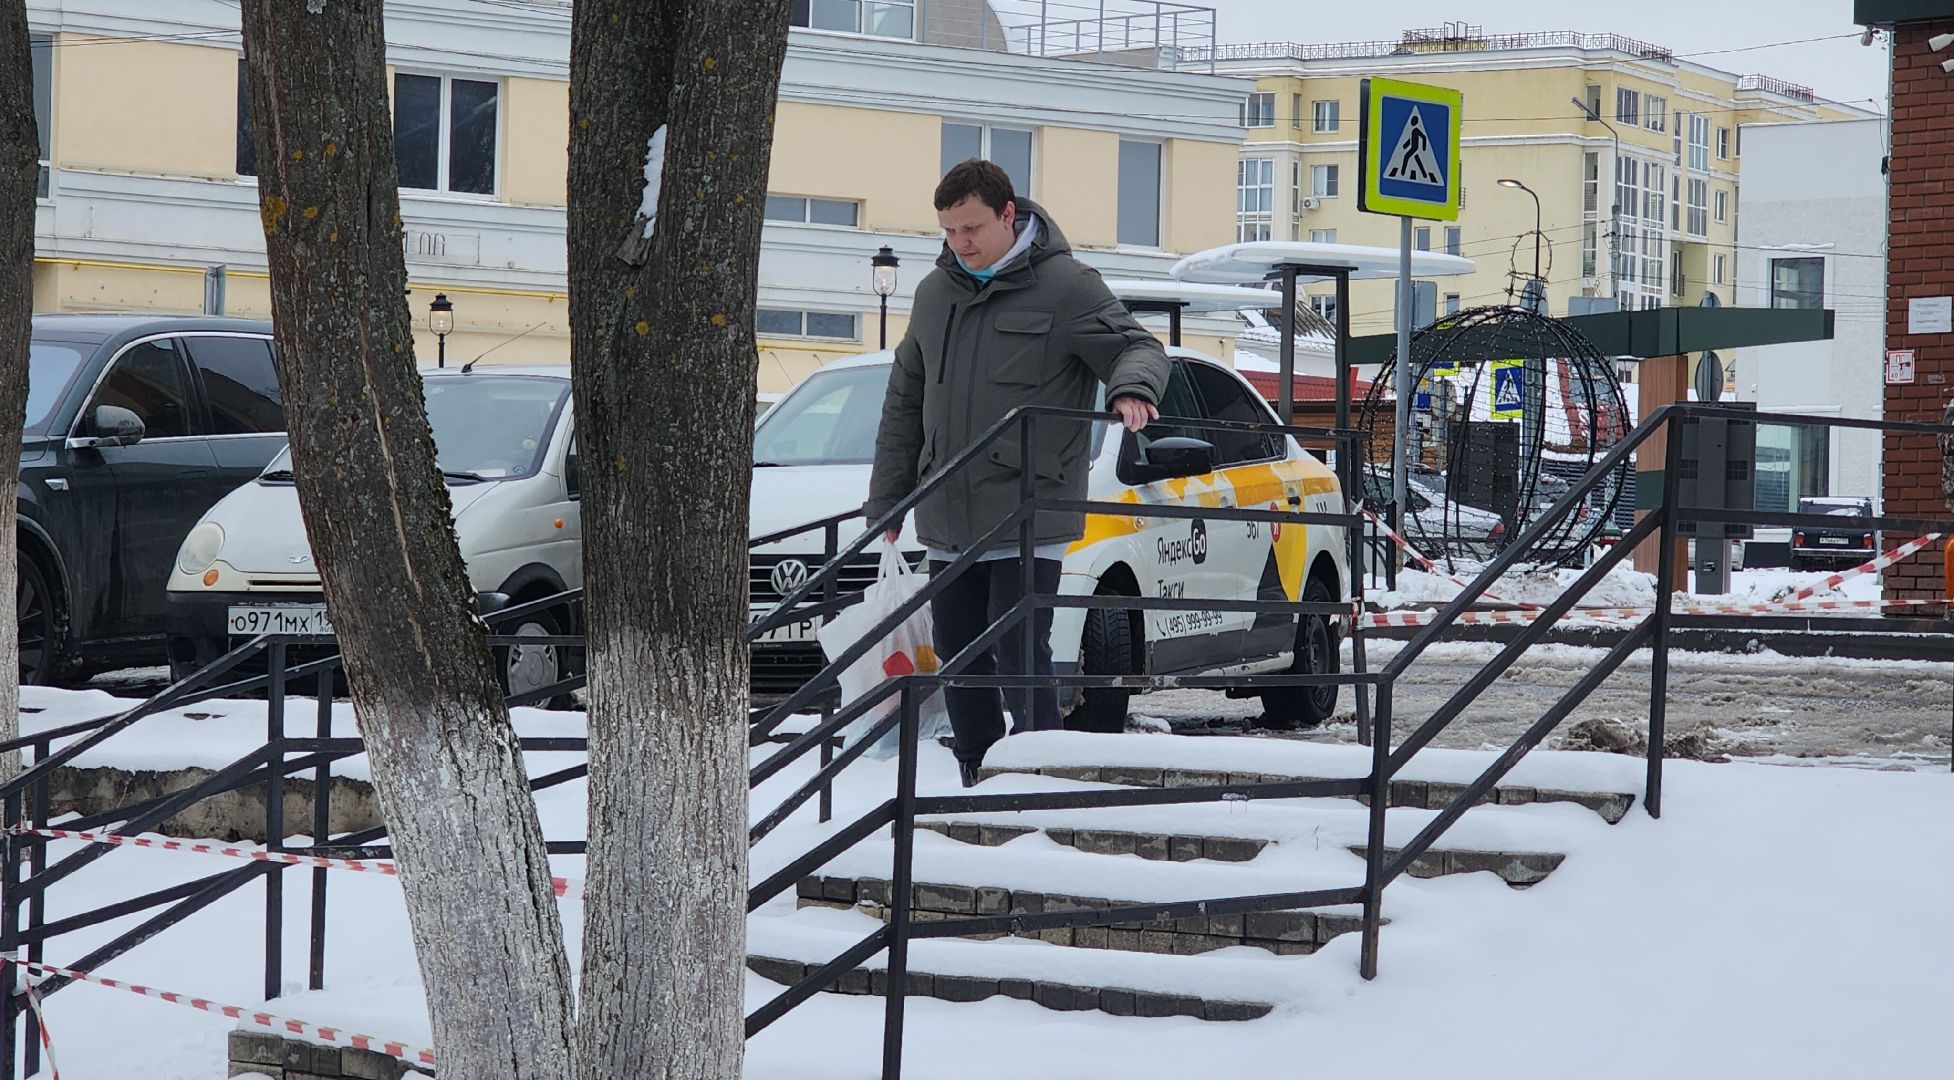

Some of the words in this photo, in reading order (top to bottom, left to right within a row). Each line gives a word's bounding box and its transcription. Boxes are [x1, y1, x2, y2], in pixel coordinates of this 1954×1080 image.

[1157, 537, 1192, 566] Яндекс
[1193, 528, 1206, 556] Go
[1157, 579, 1185, 599] Такси
[1165, 614, 1187, 638] (495)
